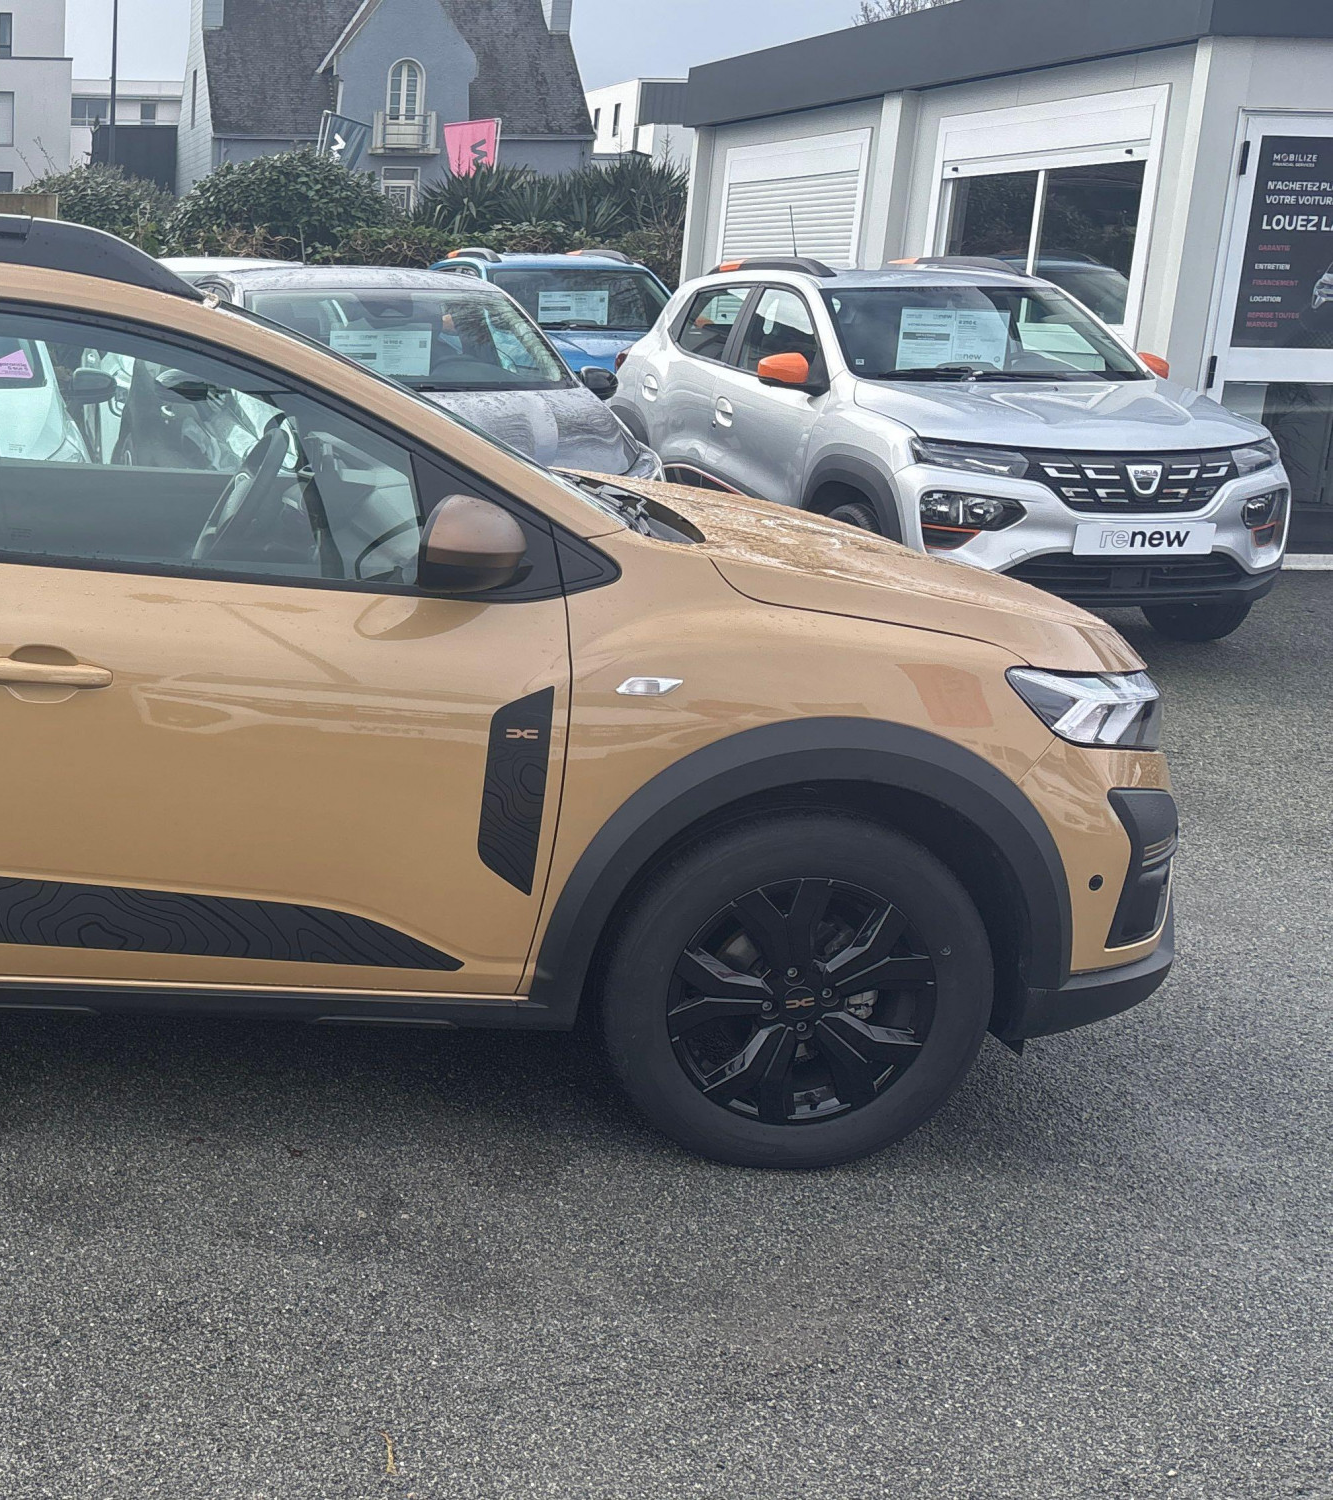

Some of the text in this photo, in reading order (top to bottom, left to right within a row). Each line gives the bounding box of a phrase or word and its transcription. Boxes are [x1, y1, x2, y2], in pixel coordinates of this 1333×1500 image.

[1273, 153, 1318, 162] MOBILIZE
[1267, 180, 1319, 191] N'ACHETEZ
[1265, 194, 1333, 205] VOTRE VOITUR
[1262, 214, 1333, 231] LOUEZ L
[1258, 244, 1291, 252] GARANTIE
[1249, 295, 1282, 303] LOCATION
[1247, 311, 1275, 319] REPRISE
[1099, 530, 1190, 548] renew
